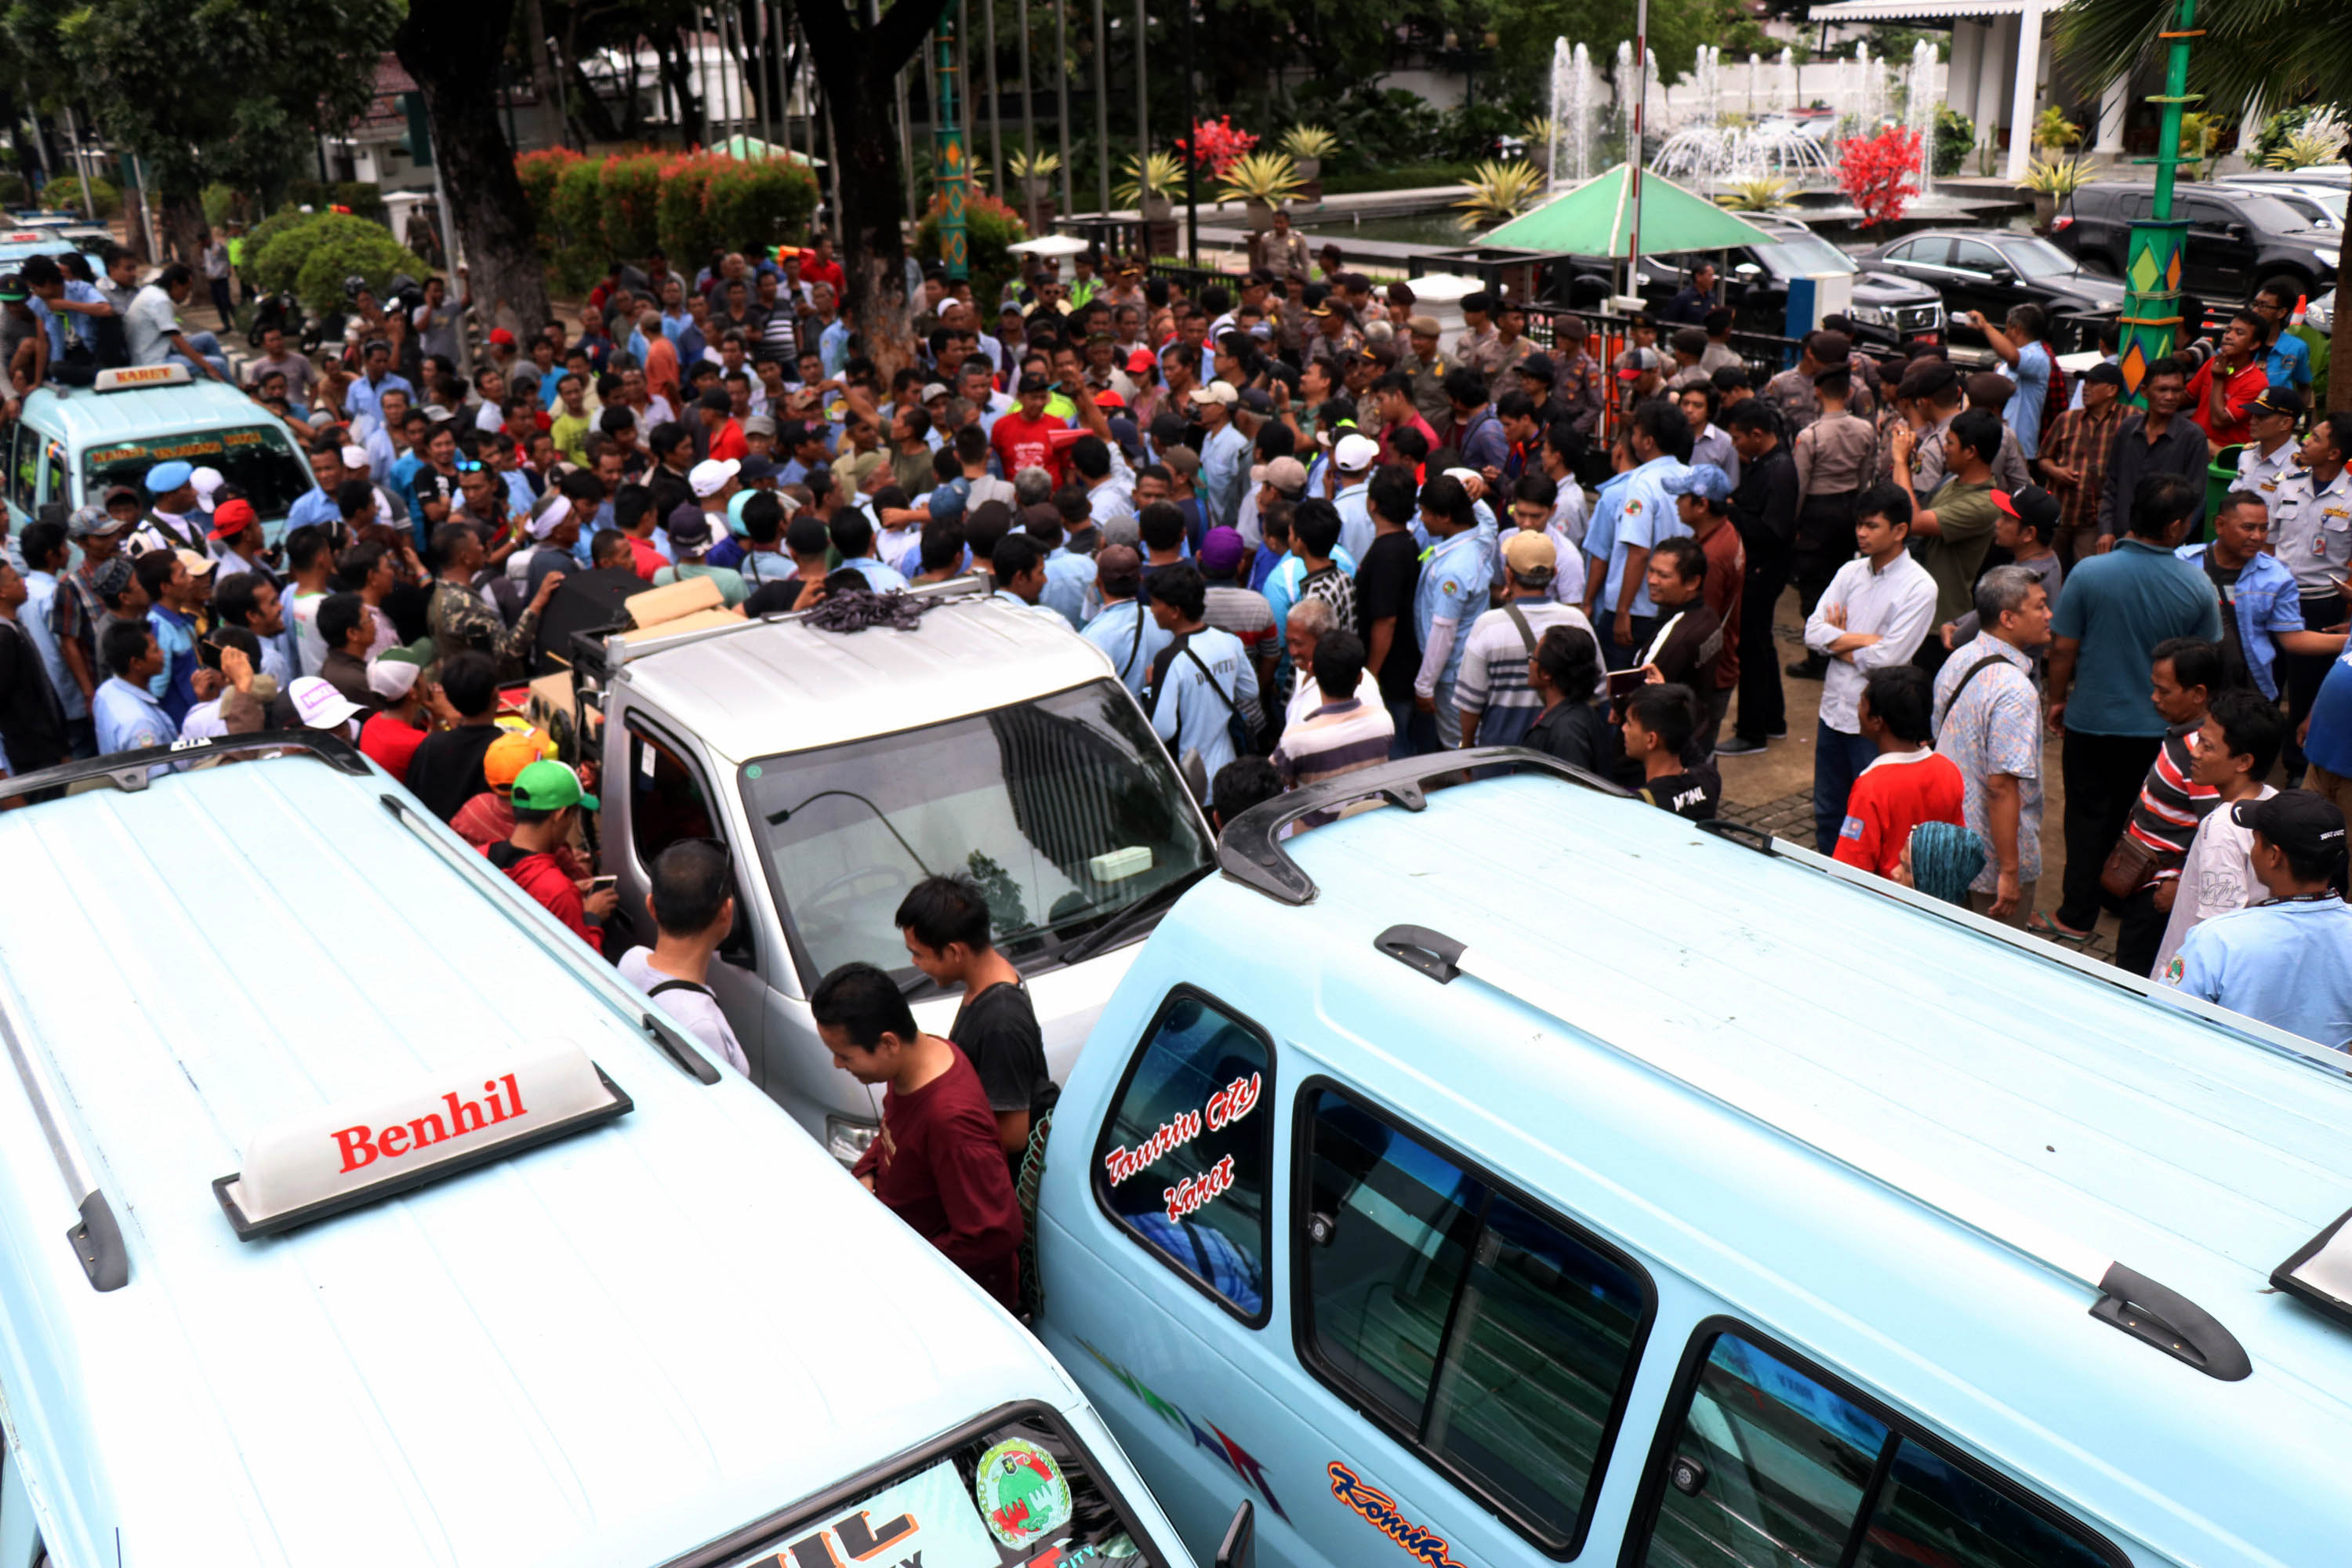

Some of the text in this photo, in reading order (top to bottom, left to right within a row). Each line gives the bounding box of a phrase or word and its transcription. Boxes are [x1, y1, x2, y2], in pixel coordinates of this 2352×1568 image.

[115, 368, 171, 383] KARET
[330, 1073, 528, 1174] Benhil
[1205, 1071, 1261, 1132] City
[1163, 1153, 1235, 1224] Karet
[1327, 1461, 1468, 1568] Komik
